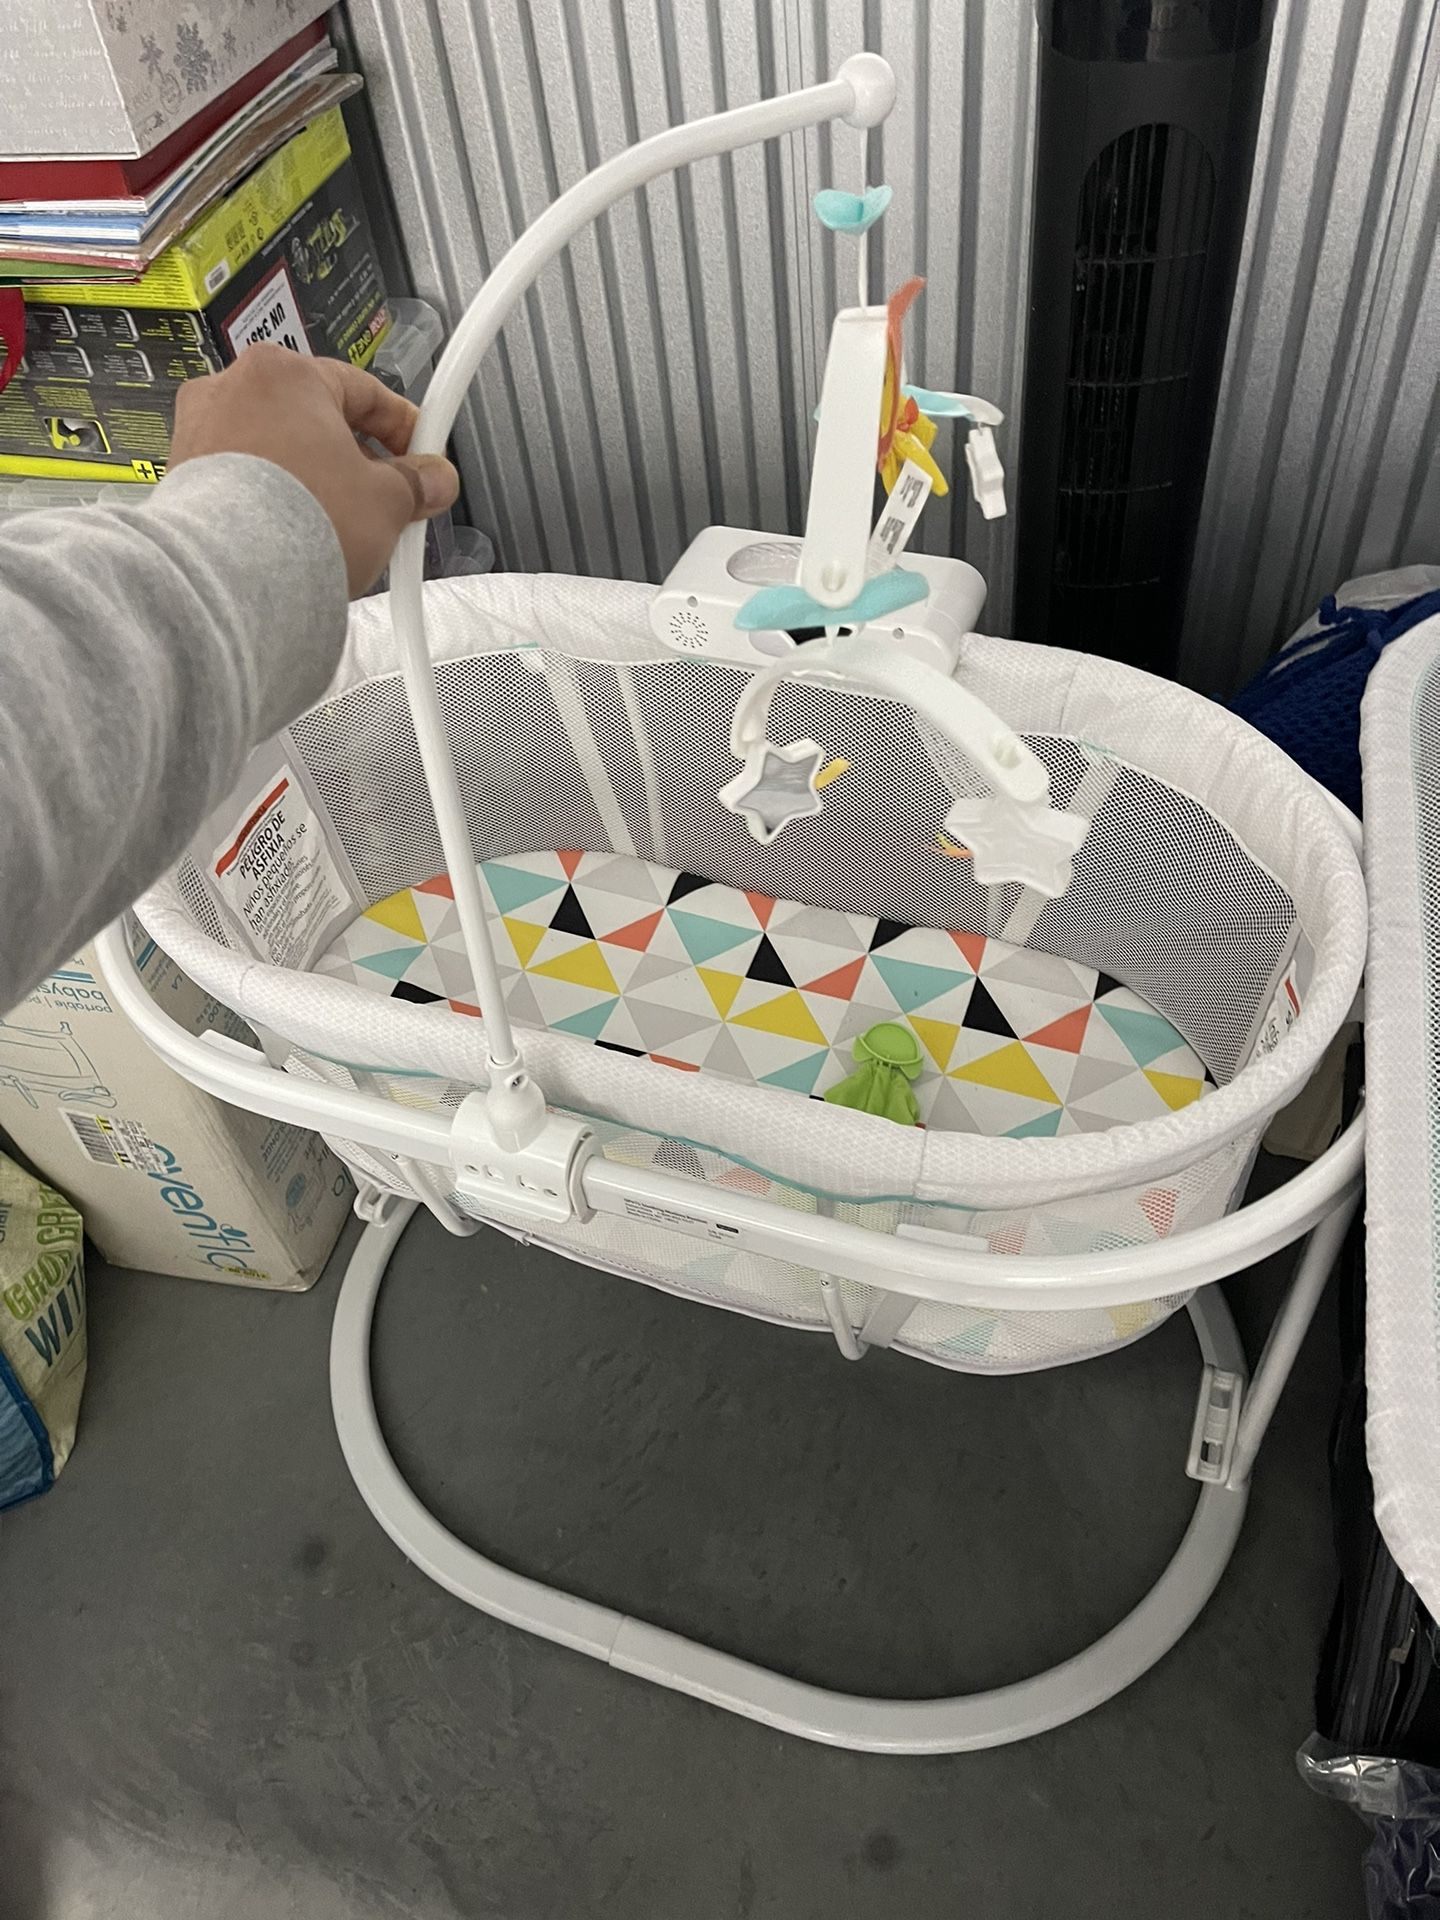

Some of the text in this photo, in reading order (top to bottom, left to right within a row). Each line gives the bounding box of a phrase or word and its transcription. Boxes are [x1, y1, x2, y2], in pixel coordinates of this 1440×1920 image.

[272, 302, 286, 330] UN
[295, 822, 306, 837] se
[239, 827, 275, 879] PELIGRO
[270, 810, 285, 831] DE
[252, 834, 285, 881] ASFIXIA
[249, 907, 266, 930] han
[55, 1000, 112, 1012] portable
